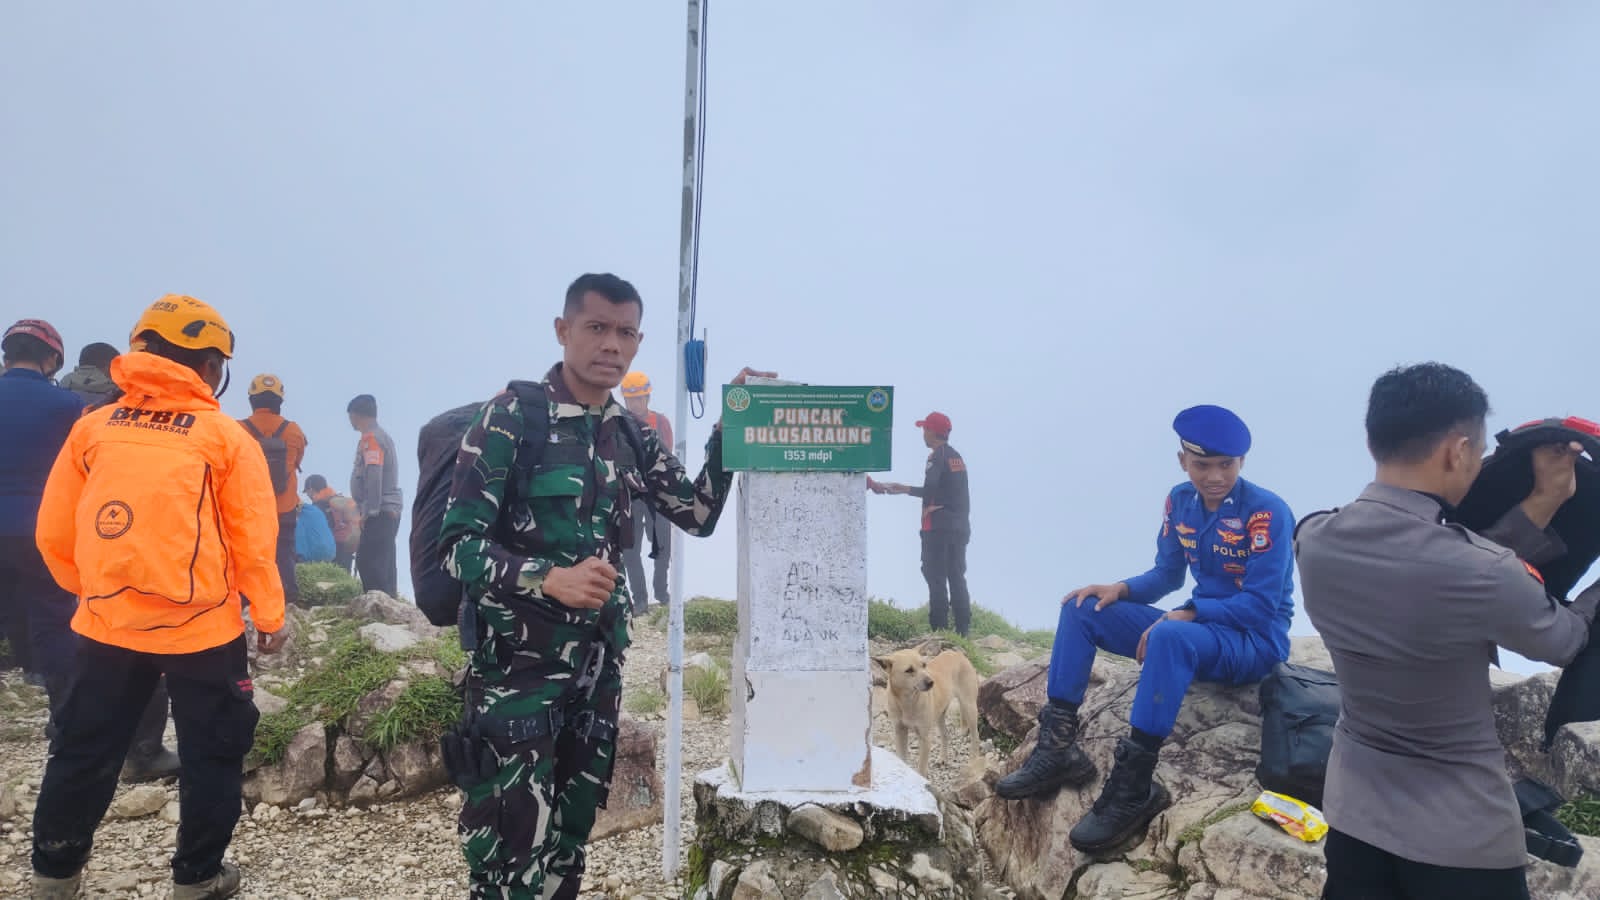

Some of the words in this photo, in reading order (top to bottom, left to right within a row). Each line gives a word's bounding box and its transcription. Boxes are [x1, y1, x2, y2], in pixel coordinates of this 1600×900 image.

[110, 407, 196, 429] BPBD
[774, 408, 844, 425] PUNCAK
[105, 419, 131, 428] KOTA
[134, 421, 189, 436] MAKASSAR
[744, 426, 872, 444] BULUSARAUNG
[784, 451, 806, 461] 1353
[1213, 544, 1250, 558] POLRI
